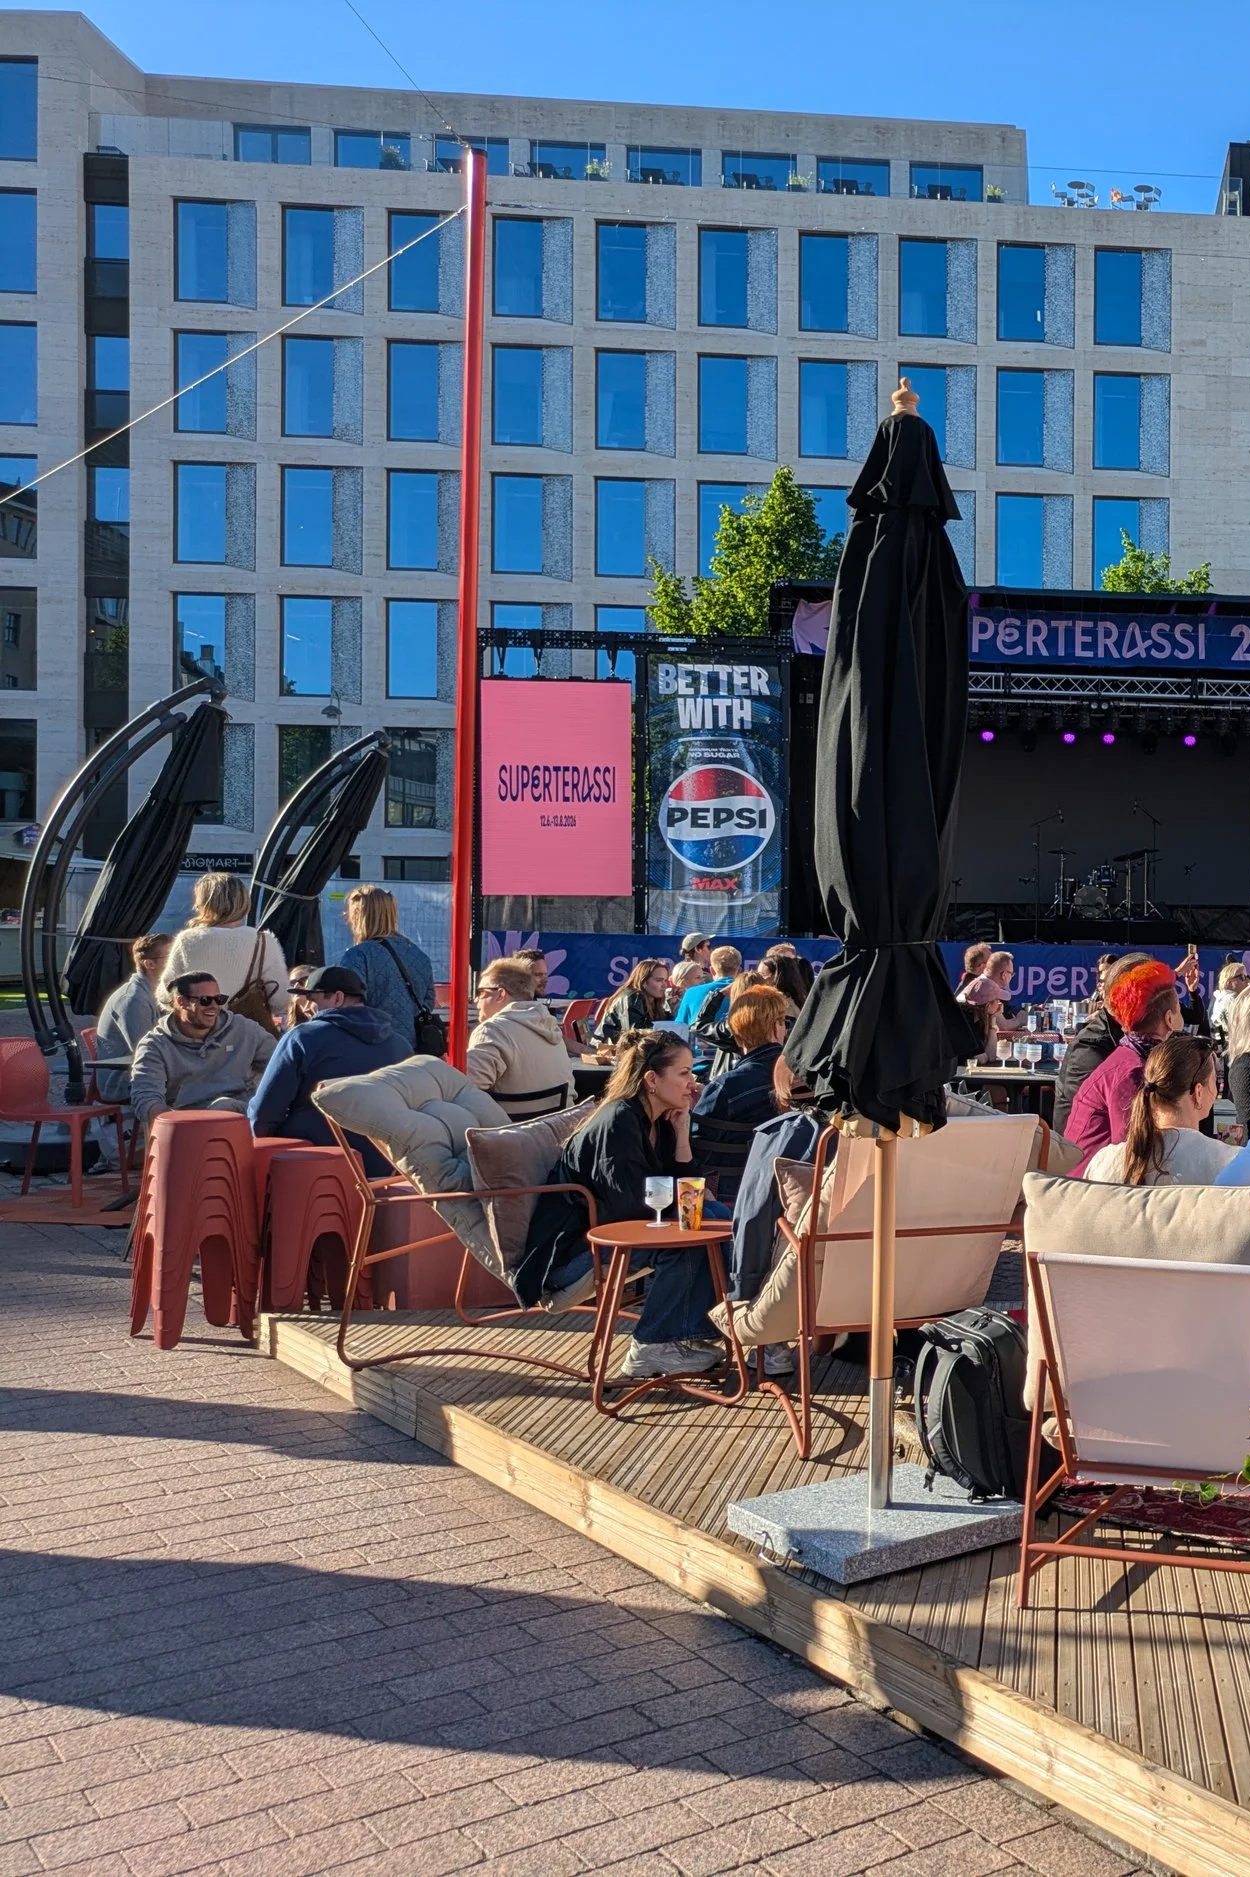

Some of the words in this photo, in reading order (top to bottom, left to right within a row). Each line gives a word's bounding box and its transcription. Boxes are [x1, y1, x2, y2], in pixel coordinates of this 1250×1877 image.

[971, 616, 1206, 660] PERTERASSI
[658, 663, 770, 696] BETTER
[677, 698, 752, 730] WITH
[703, 751, 740, 759] SUGAR
[498, 764, 616, 803] SUPERTERASSI
[666, 807, 767, 830] PEPSI
[691, 877, 738, 890] MAX
